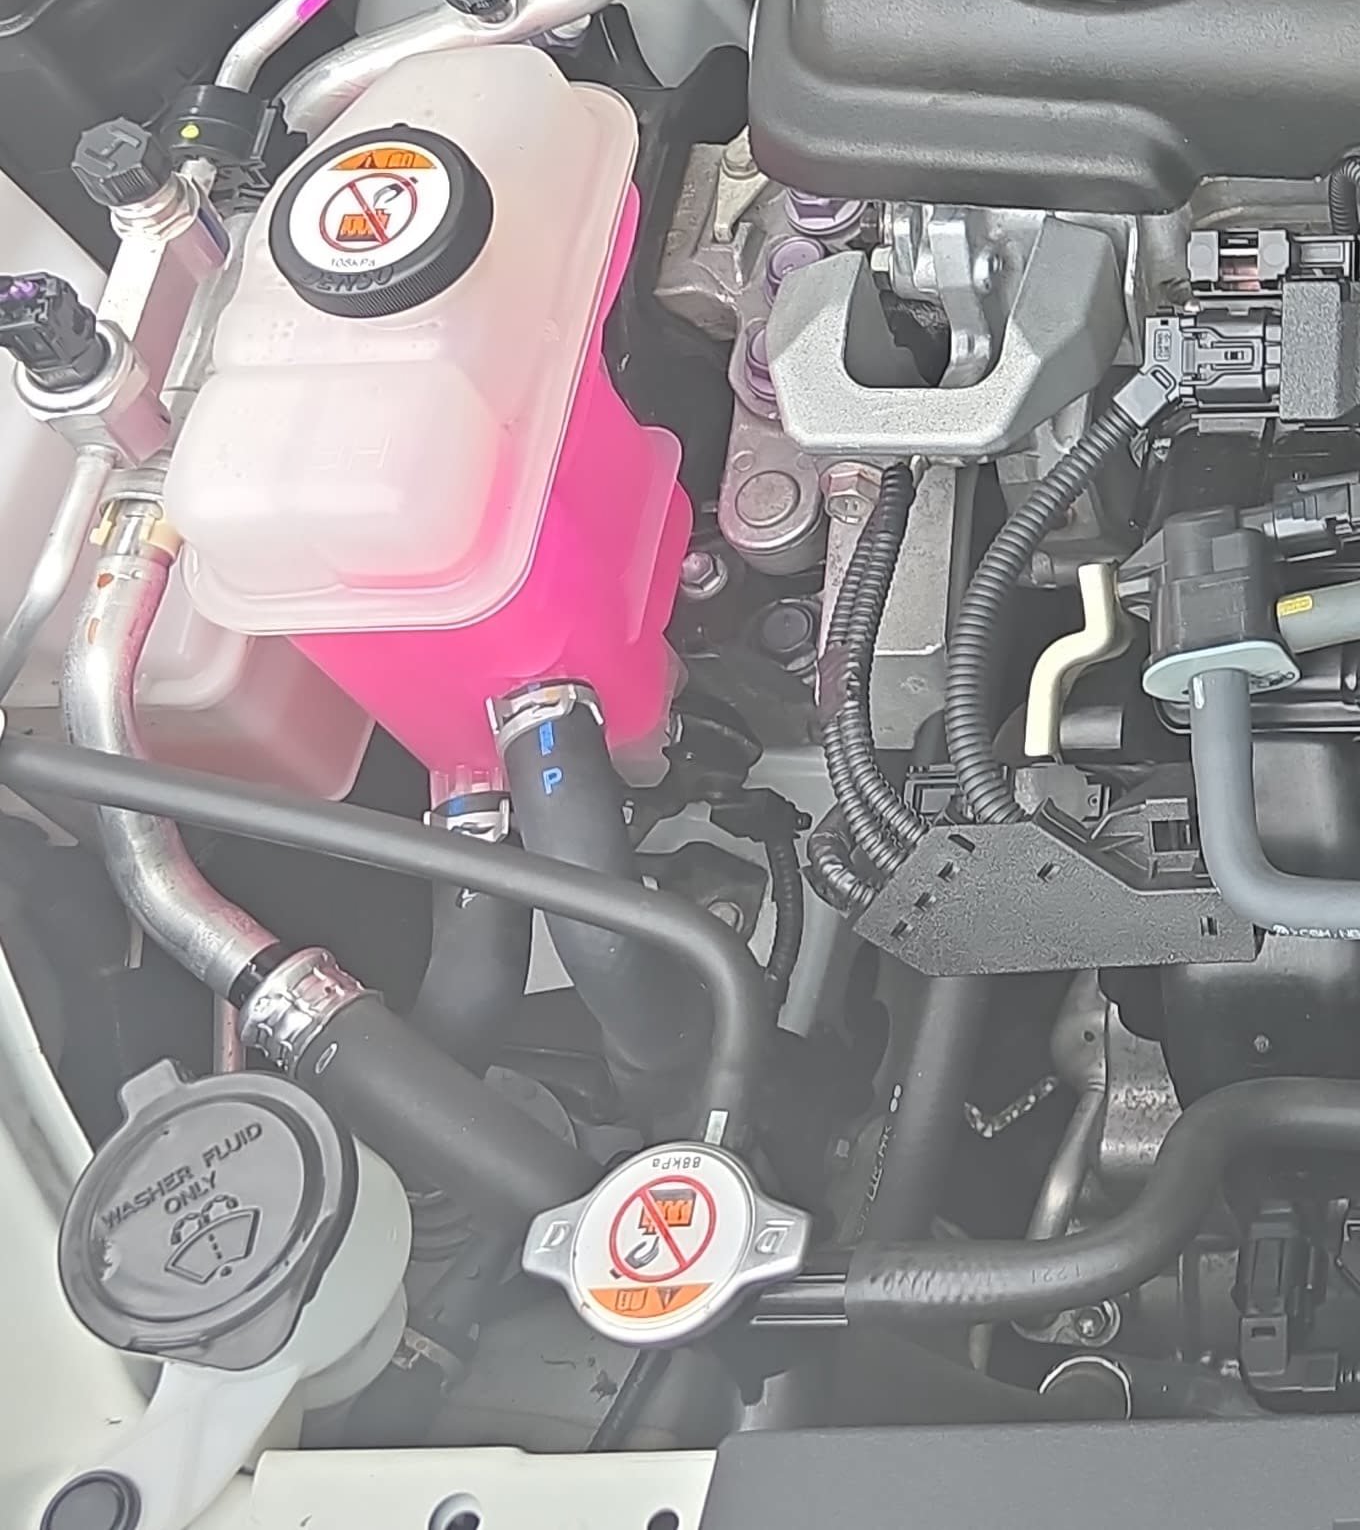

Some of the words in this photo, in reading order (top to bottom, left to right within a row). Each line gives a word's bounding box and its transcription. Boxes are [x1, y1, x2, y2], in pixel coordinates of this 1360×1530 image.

[299, 265, 394, 292] DENSO
[102, 1165, 195, 1229] WASHER
[202, 1122, 263, 1168] FLUID
[652, 1156, 702, 1170] 88kPa
[164, 1170, 217, 1215] ONLY
